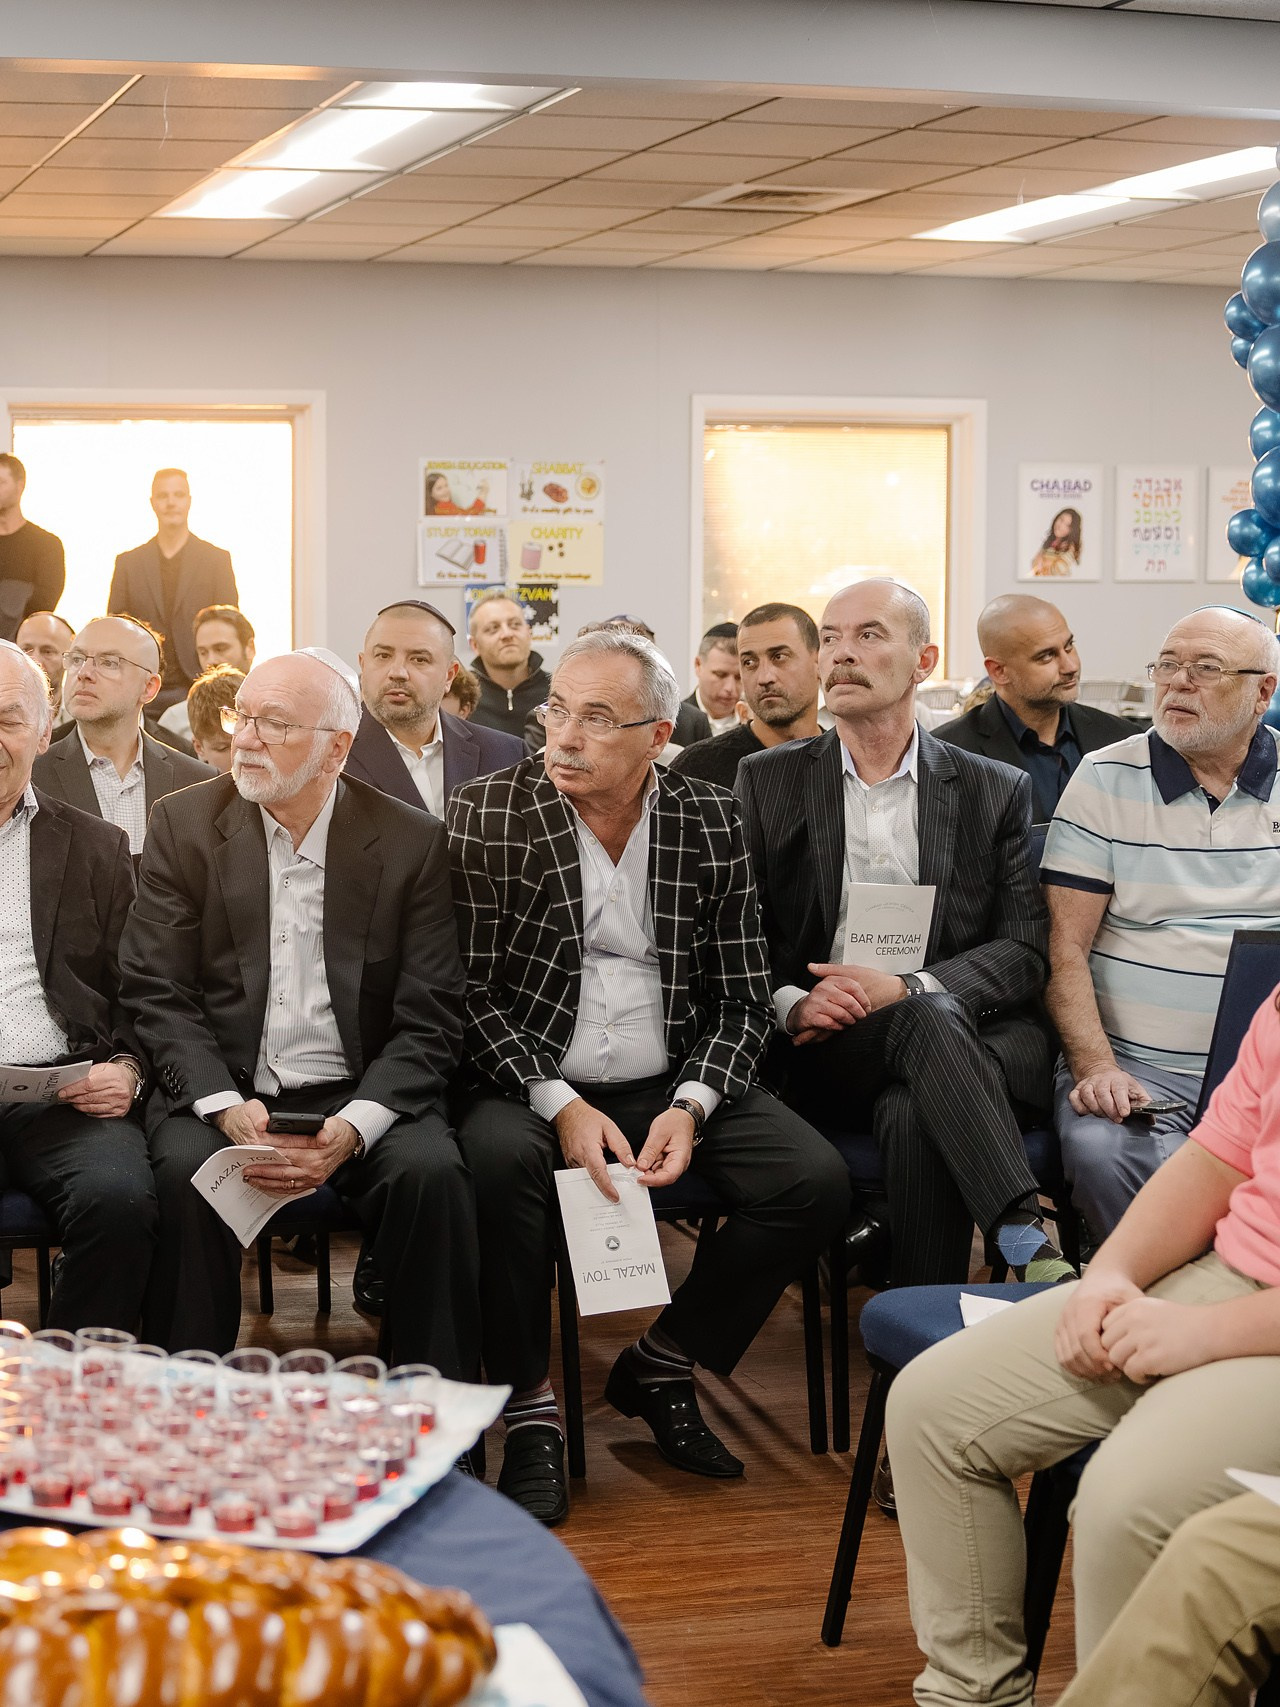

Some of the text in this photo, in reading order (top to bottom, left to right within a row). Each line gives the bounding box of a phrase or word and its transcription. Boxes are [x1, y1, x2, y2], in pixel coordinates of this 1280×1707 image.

[532, 463, 584, 474] SHABBAT
[1030, 479, 1092, 491] CHABAD
[426, 527, 496, 538] STUDY TORAH
[531, 527, 583, 539] CHARITY
[850, 933, 922, 944] BAR MITZVAH
[875, 946, 922, 956] CEREMONY
[210, 1161, 247, 1193] MAZAL
[582, 1262, 656, 1284] MAZAL TOV!
